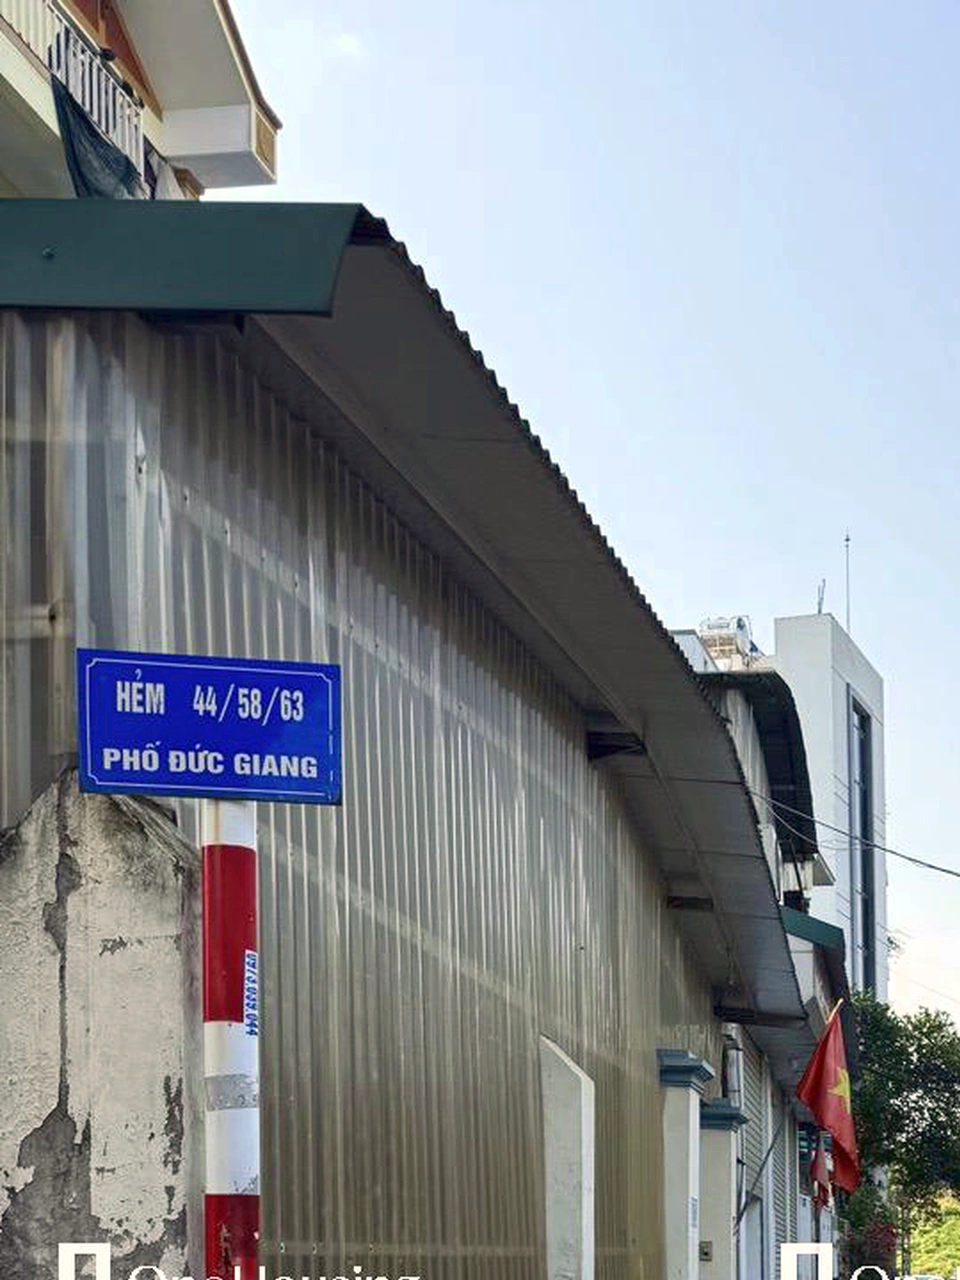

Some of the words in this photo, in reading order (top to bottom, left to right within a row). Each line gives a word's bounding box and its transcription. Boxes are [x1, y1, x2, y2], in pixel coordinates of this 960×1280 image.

[115, 669, 165, 715] HẺM
[192, 683, 304, 727] 44/58/63
[102, 741, 161, 773] PHỐ
[168, 743, 225, 775] ĐỨC
[233, 753, 318, 779] GIANG
